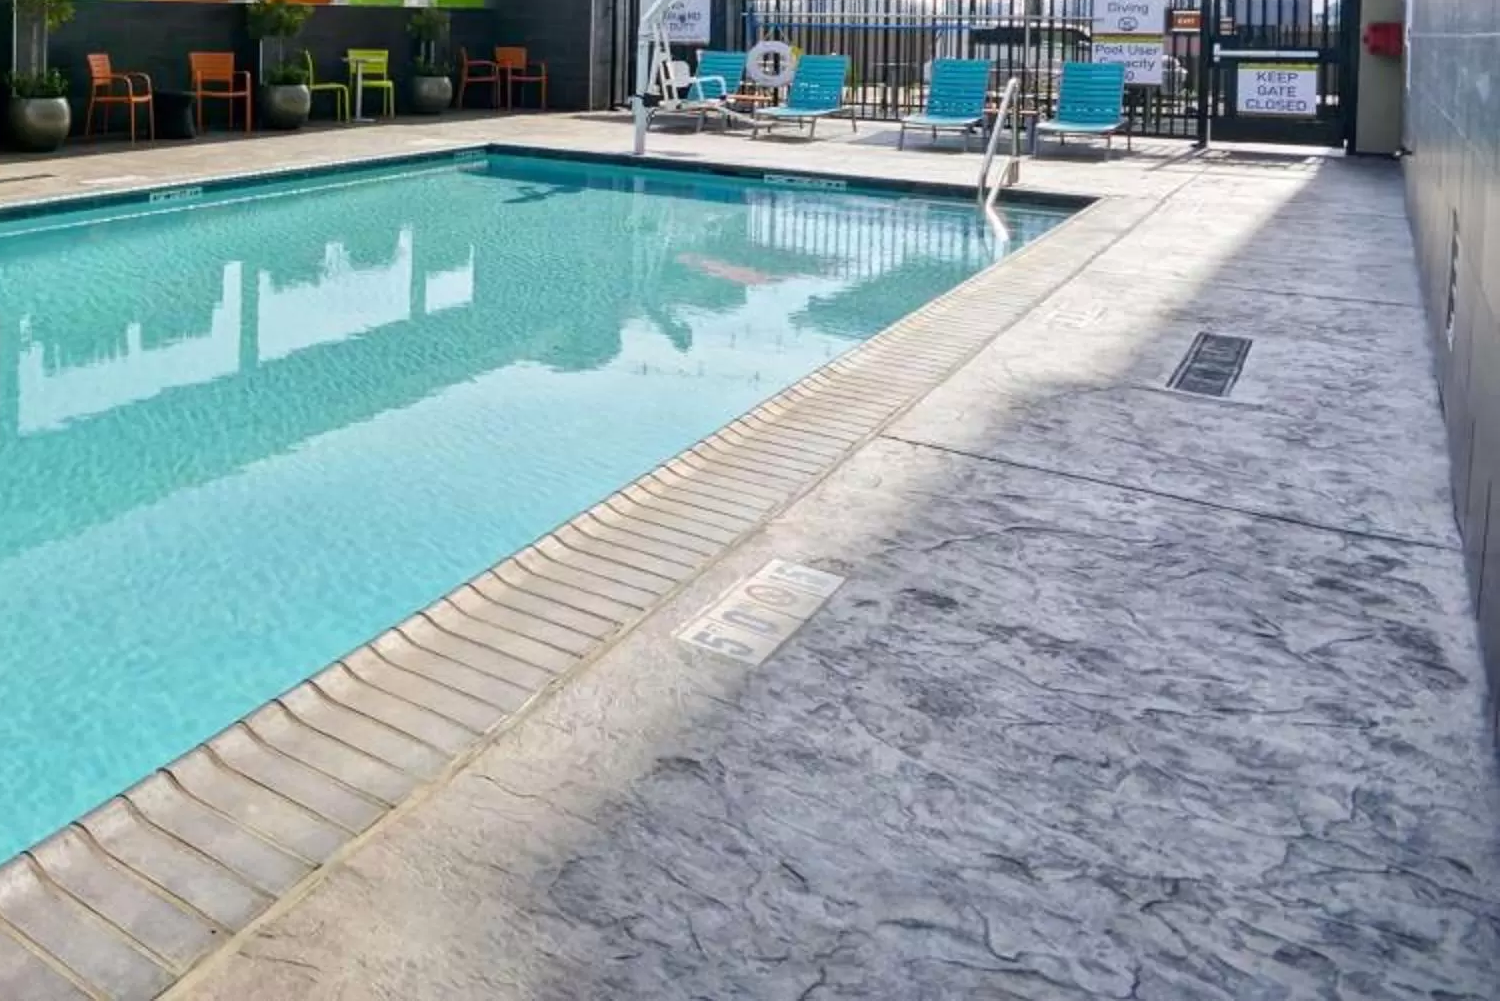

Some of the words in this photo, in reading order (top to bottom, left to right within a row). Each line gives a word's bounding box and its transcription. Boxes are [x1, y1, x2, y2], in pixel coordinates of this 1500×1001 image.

[1107, 2, 1149, 16] Diving
[1096, 44, 1124, 56] Pool
[1128, 44, 1157, 56] User
[1256, 71, 1299, 83] KEEP
[1257, 85, 1297, 97] GATE
[1245, 98, 1307, 111] CLOSED
